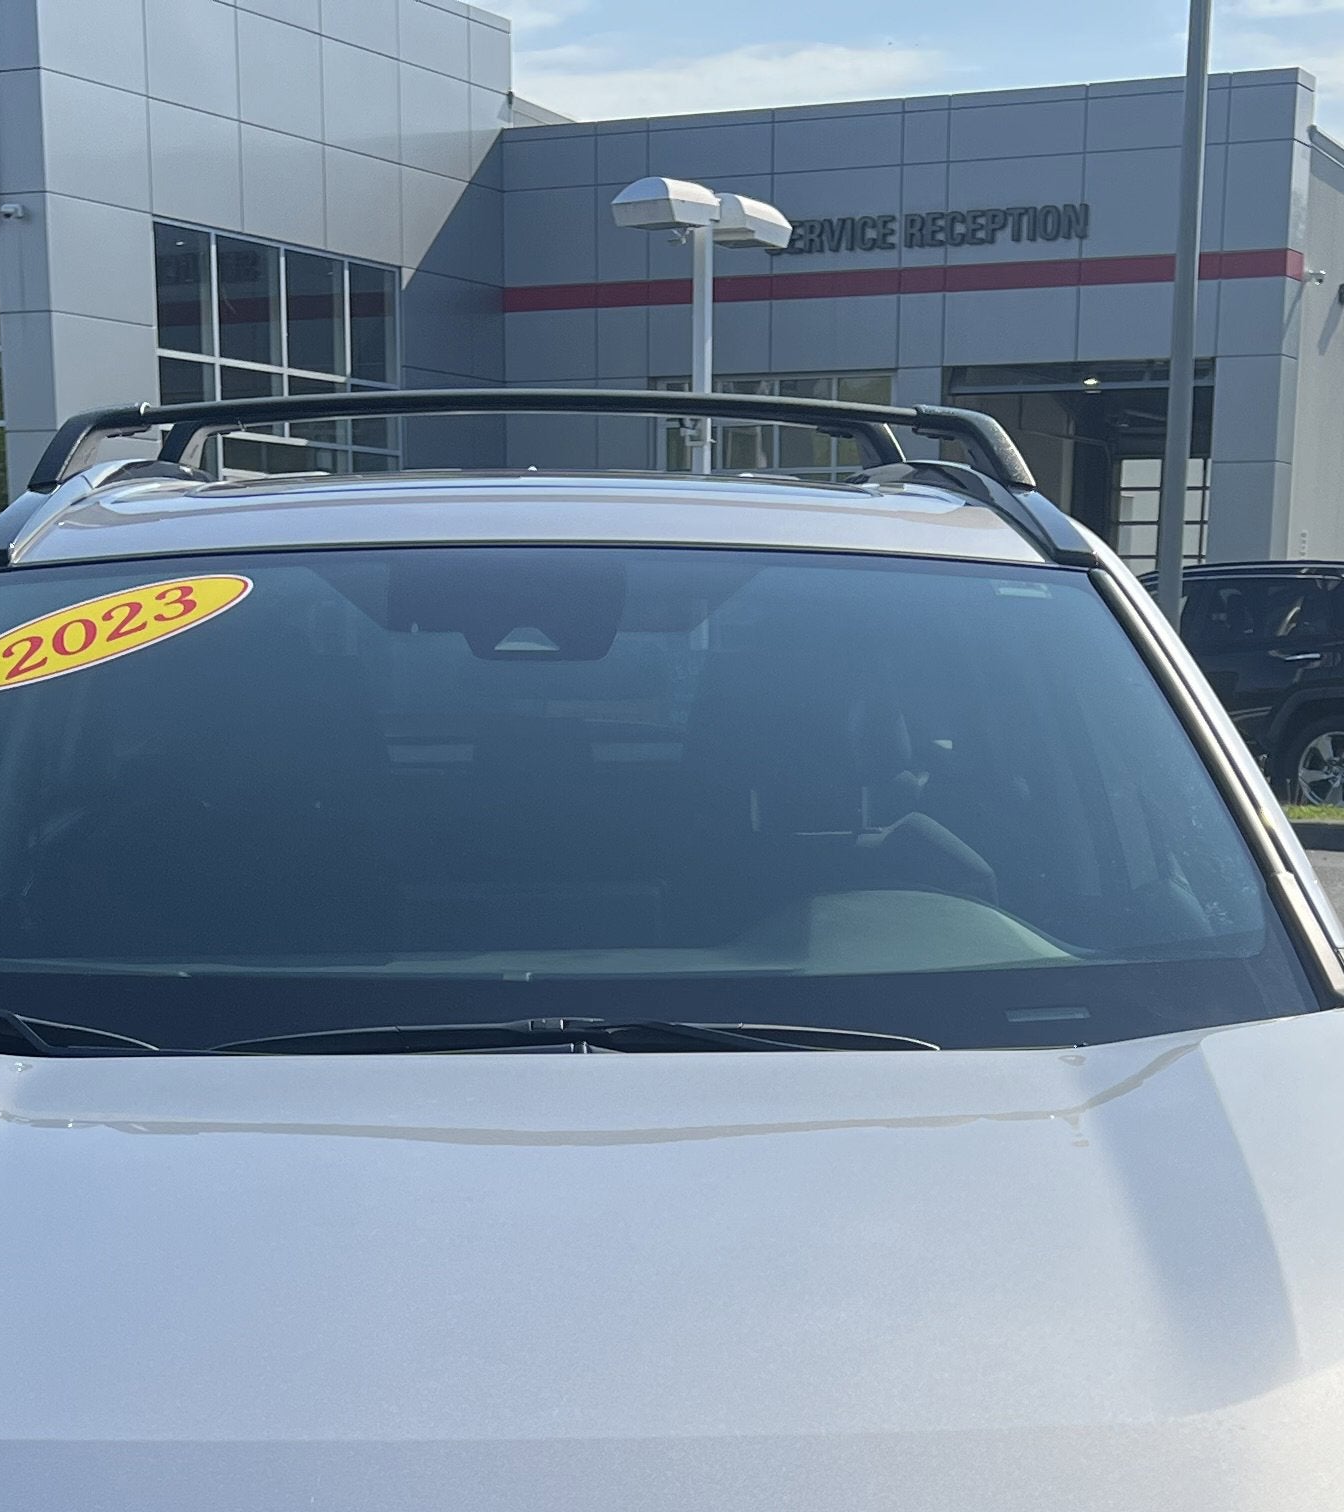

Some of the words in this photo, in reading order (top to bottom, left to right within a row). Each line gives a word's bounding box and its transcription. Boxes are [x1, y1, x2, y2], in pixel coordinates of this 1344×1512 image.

[764, 214, 897, 255] ERVICE
[903, 203, 1090, 249] RECEPTION
[1, 585, 197, 681] 2023
